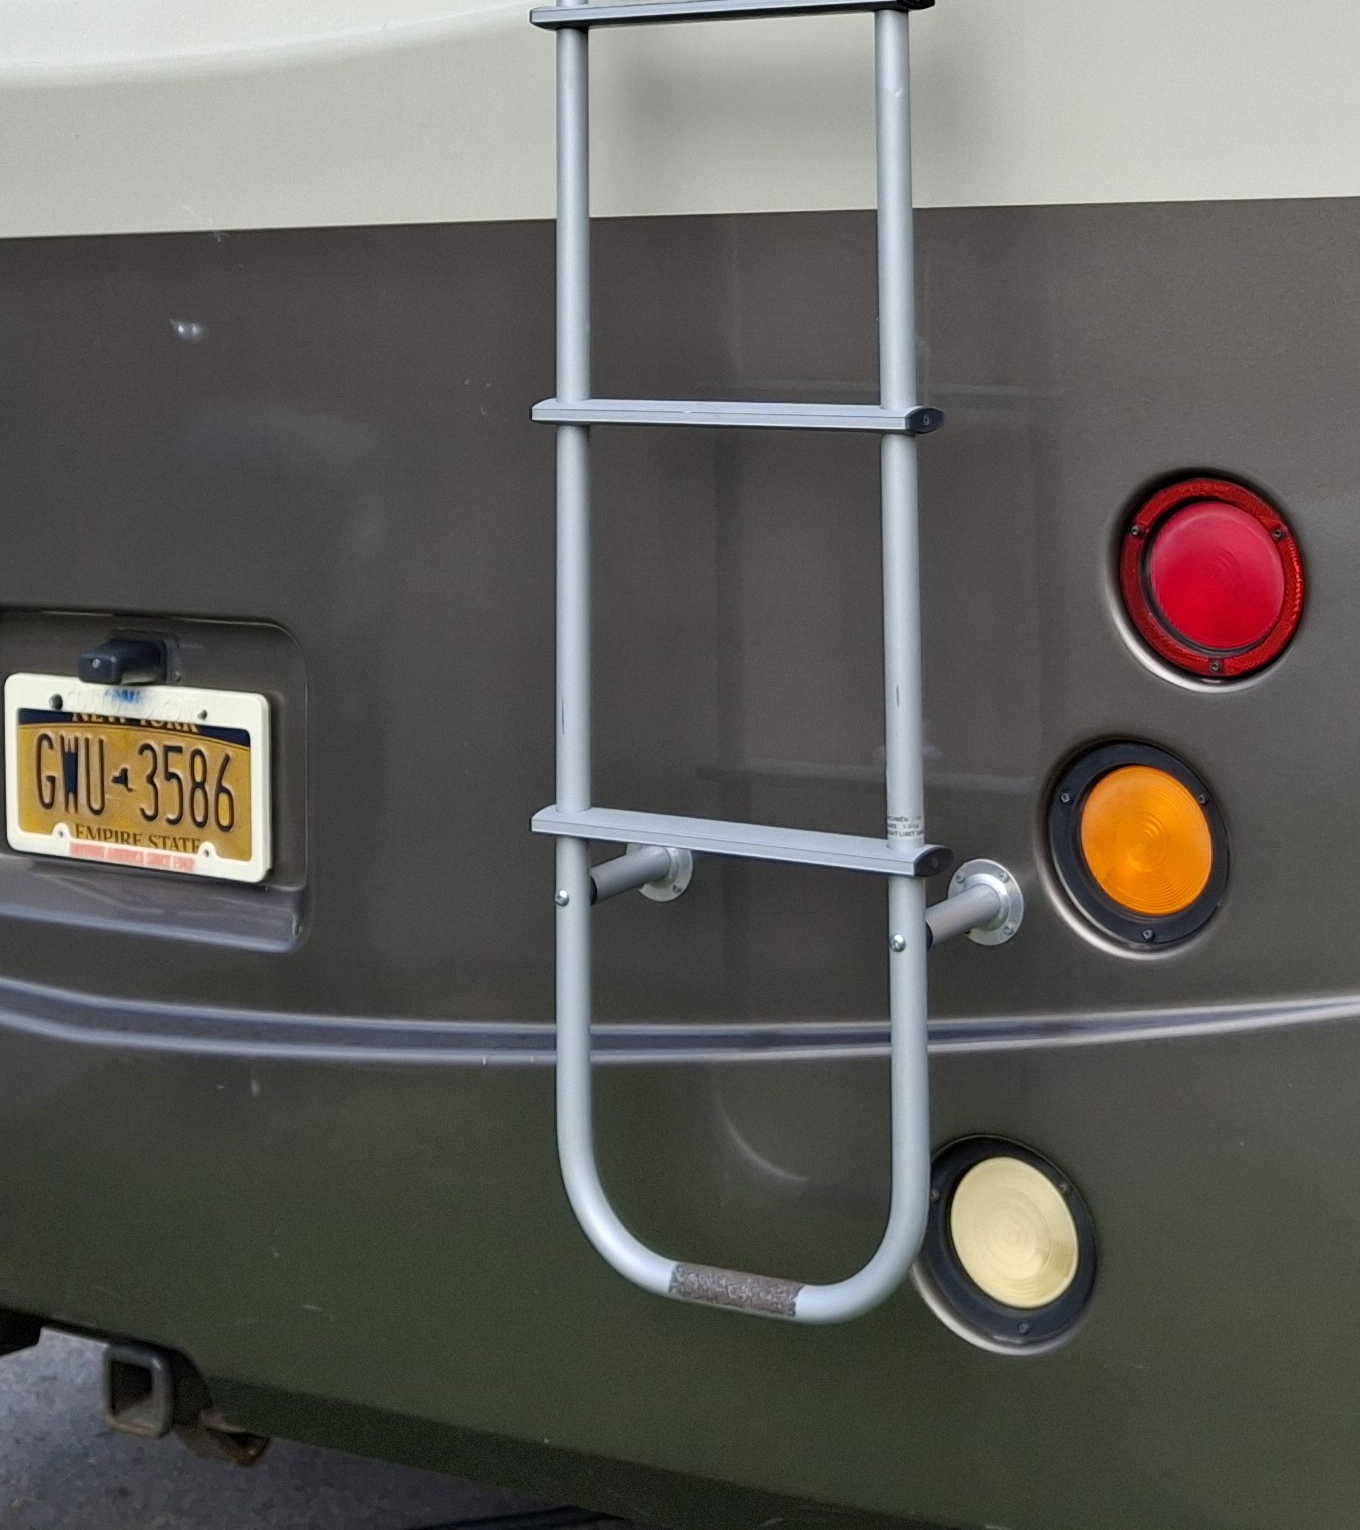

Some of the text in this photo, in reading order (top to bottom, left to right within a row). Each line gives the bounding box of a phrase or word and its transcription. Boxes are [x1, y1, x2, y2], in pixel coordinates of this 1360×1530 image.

[138, 742, 235, 832] 3586
[74, 823, 201, 855] EMPIRE STATE
